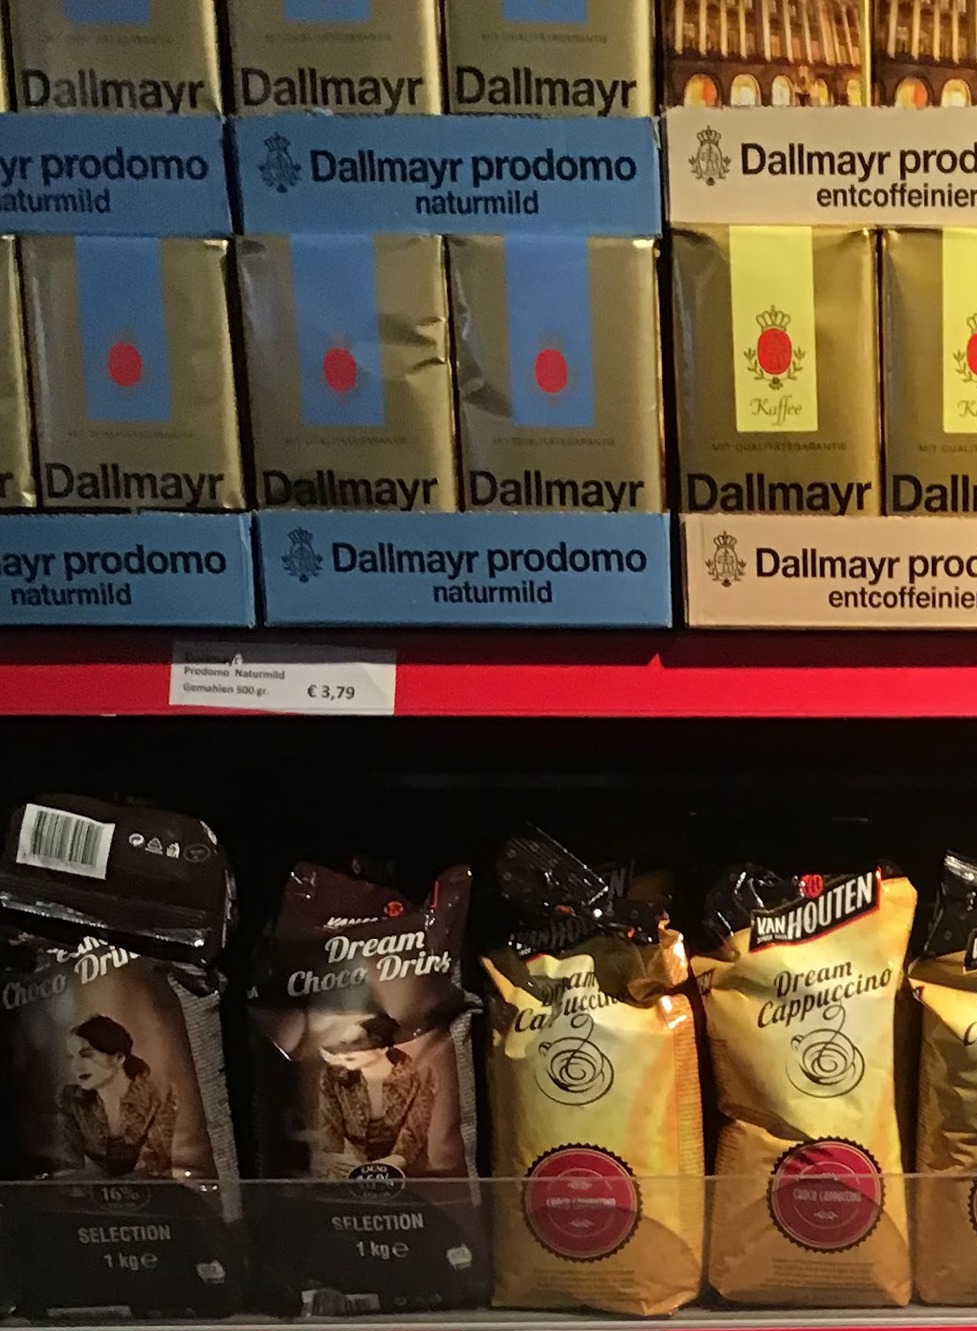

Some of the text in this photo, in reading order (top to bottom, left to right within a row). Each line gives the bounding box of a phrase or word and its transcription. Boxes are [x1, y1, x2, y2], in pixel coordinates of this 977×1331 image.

[22, 69, 205, 115] Dallmayr
[241, 68, 424, 113] Dallmayr
[456, 67, 637, 117] Dallmayr
[42, 148, 208, 186] prodomo
[311, 150, 637, 192] Dallmayr prodomo
[741, 143, 890, 182] Dallmayr
[416, 190, 539, 215] naturmild
[750, 395, 803, 427] Kaffee
[46, 463, 225, 508] Dallmayr
[687, 473, 872, 515] Dallmayr
[65, 544, 226, 582] prodomo
[332, 542, 647, 582] Dallmayr prodomo
[756, 547, 900, 585] Dallmayr
[11, 582, 132, 606] naturmild
[433, 580, 553, 605] naturmild
[235, 669, 285, 680] Naturmild
[307, 685, 355, 700] € 3,79
[757, 872, 873, 940] VAN HOUTEN
[326, 932, 425, 964] Dream
[288, 954, 453, 999] Choco Drink
[774, 961, 853, 998] Dream
[757, 967, 892, 1028] Cappuccino
[79, 1224, 171, 1245] SELECTION
[332, 1214, 424, 1232] SELECTION
